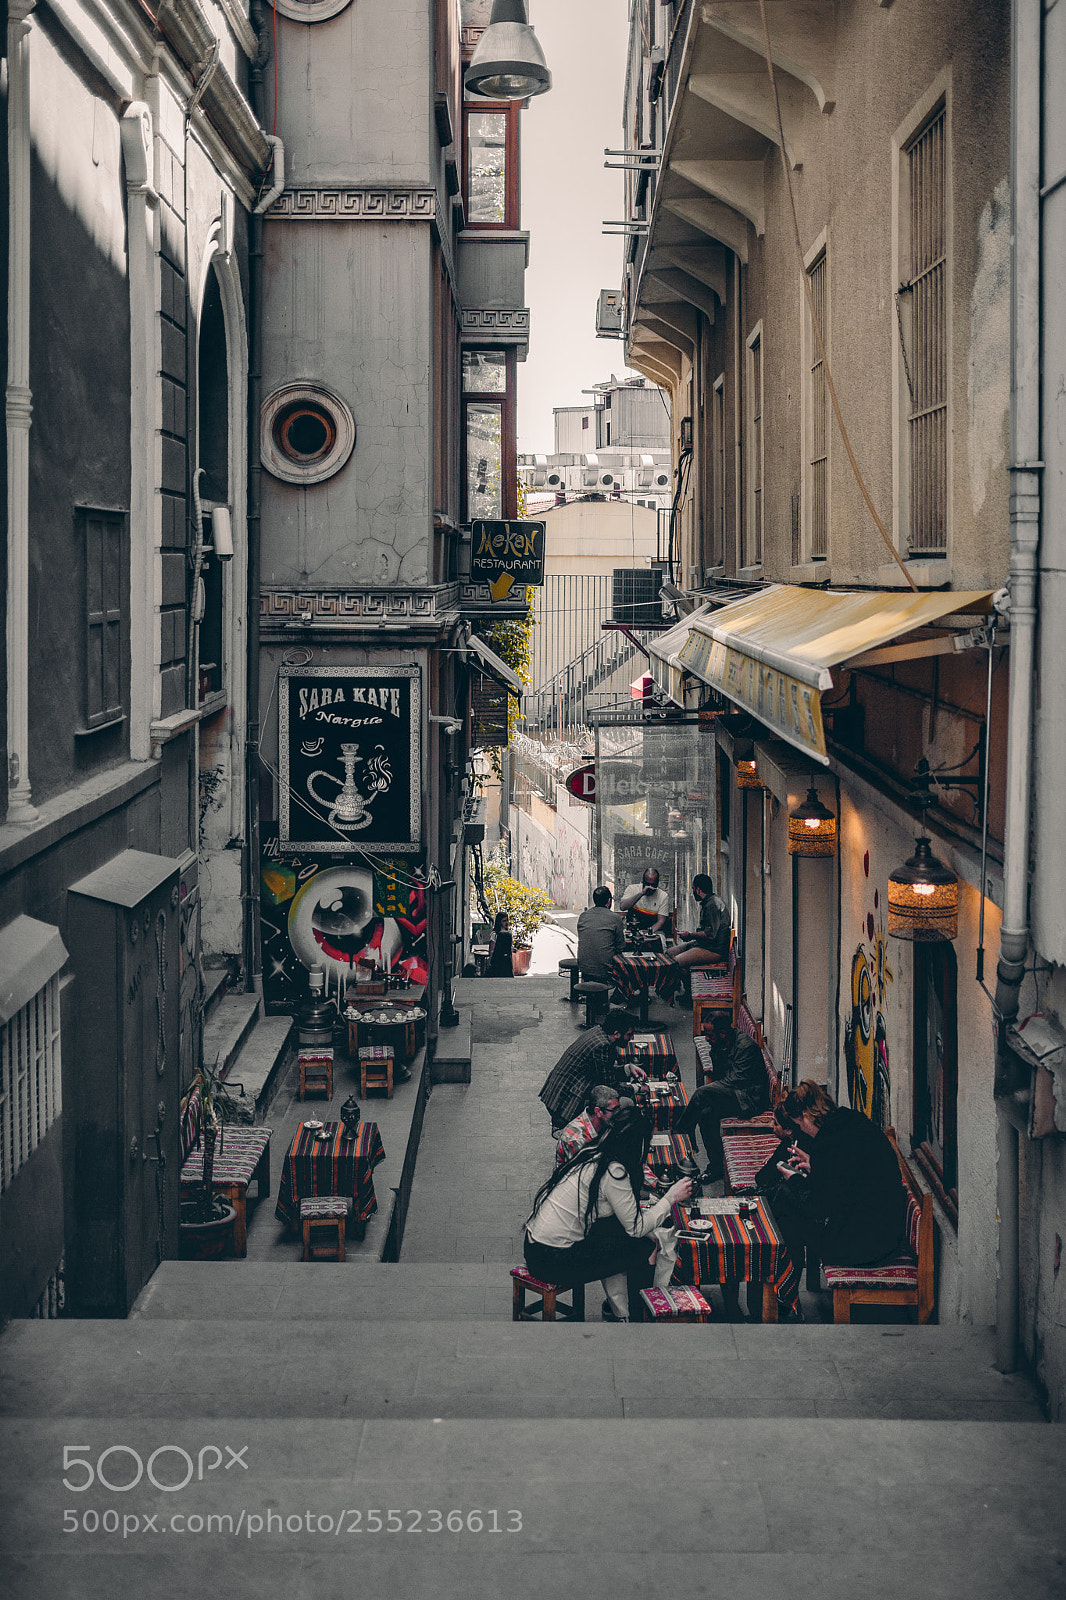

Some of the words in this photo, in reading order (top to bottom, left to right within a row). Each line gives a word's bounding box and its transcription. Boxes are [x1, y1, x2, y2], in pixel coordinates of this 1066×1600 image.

[473, 559, 541, 570] RESTAURANT
[299, 687, 346, 718] SARA
[352, 687, 400, 718] KAFE
[617, 845, 642, 860] SARA
